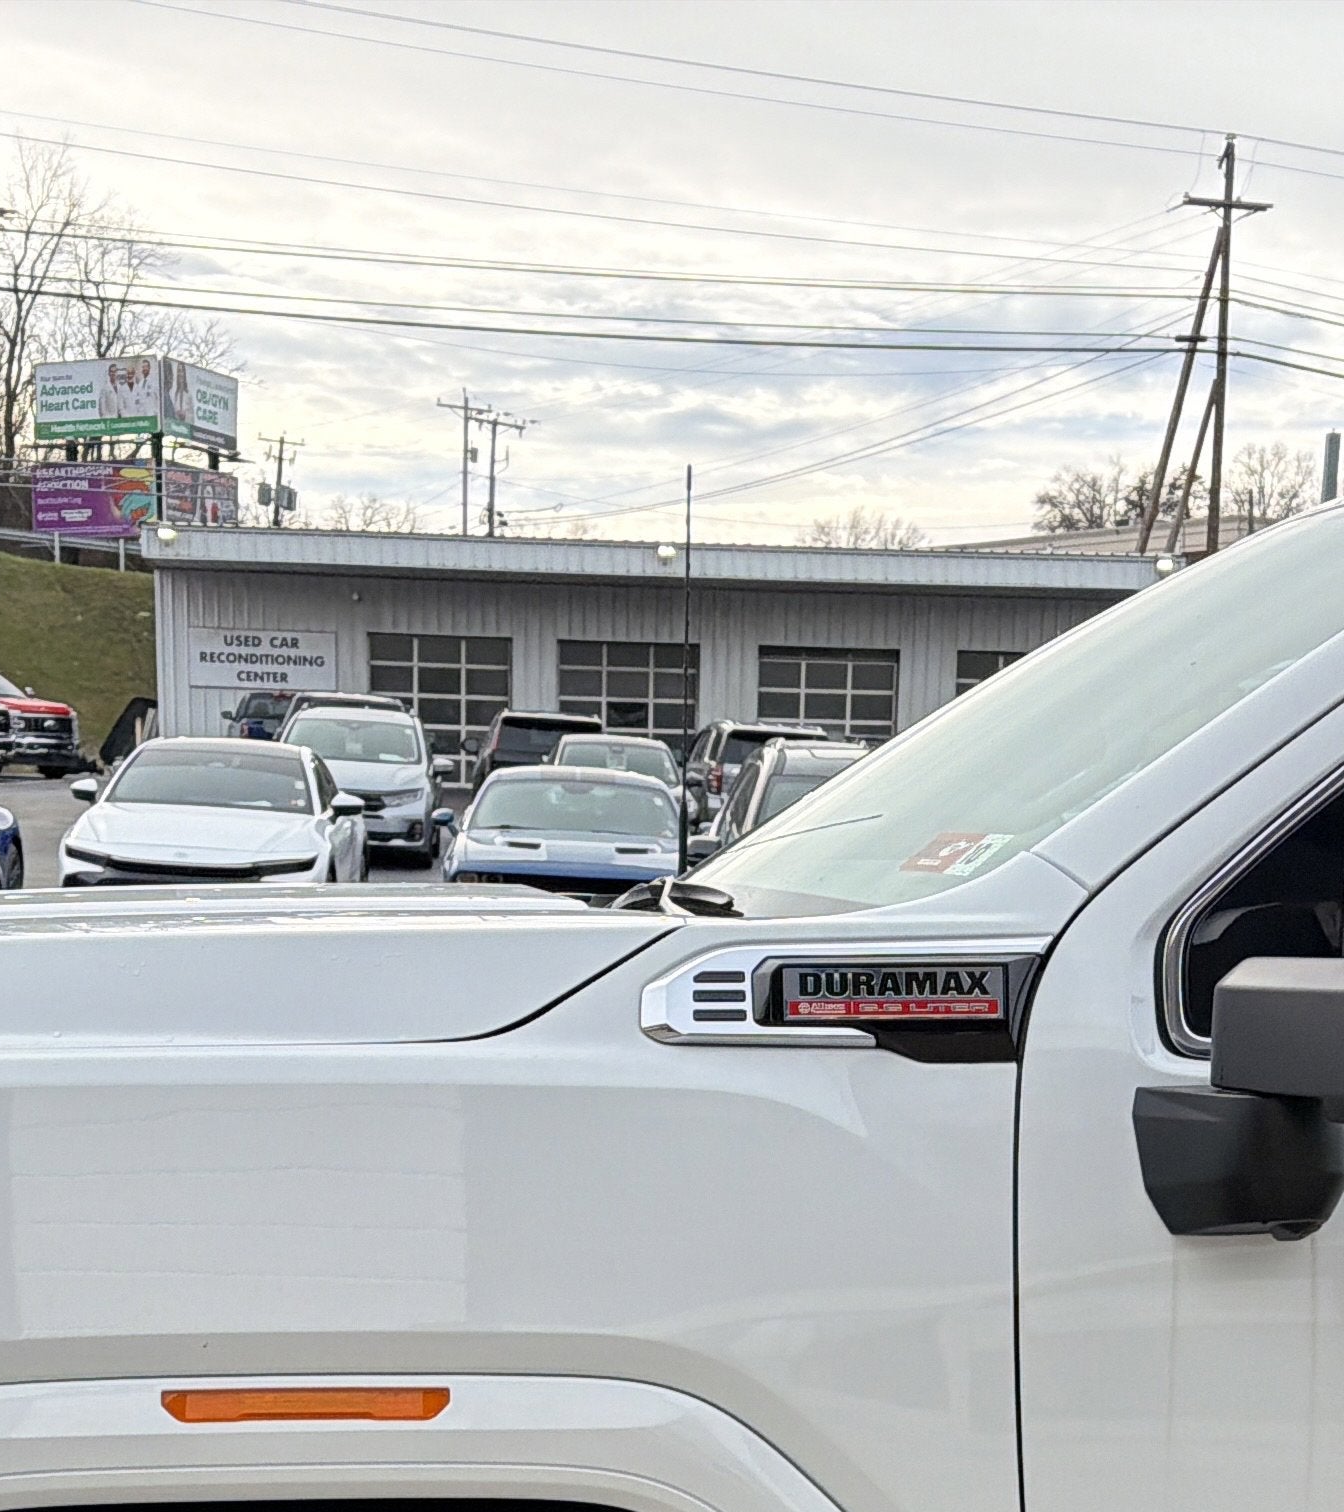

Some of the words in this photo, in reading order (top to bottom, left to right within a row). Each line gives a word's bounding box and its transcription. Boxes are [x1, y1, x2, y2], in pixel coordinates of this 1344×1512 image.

[40, 382, 93, 397] Advanced
[40, 399, 70, 412] Heart
[71, 398, 96, 410] Care
[224, 635, 262, 648] USED
[269, 636, 300, 649] CAR
[199, 652, 326, 668] RECONDITIONING
[236, 670, 289, 683] CENTER
[798, 970, 992, 998] DURAMAX
[909, 1002, 990, 1012] LITER
